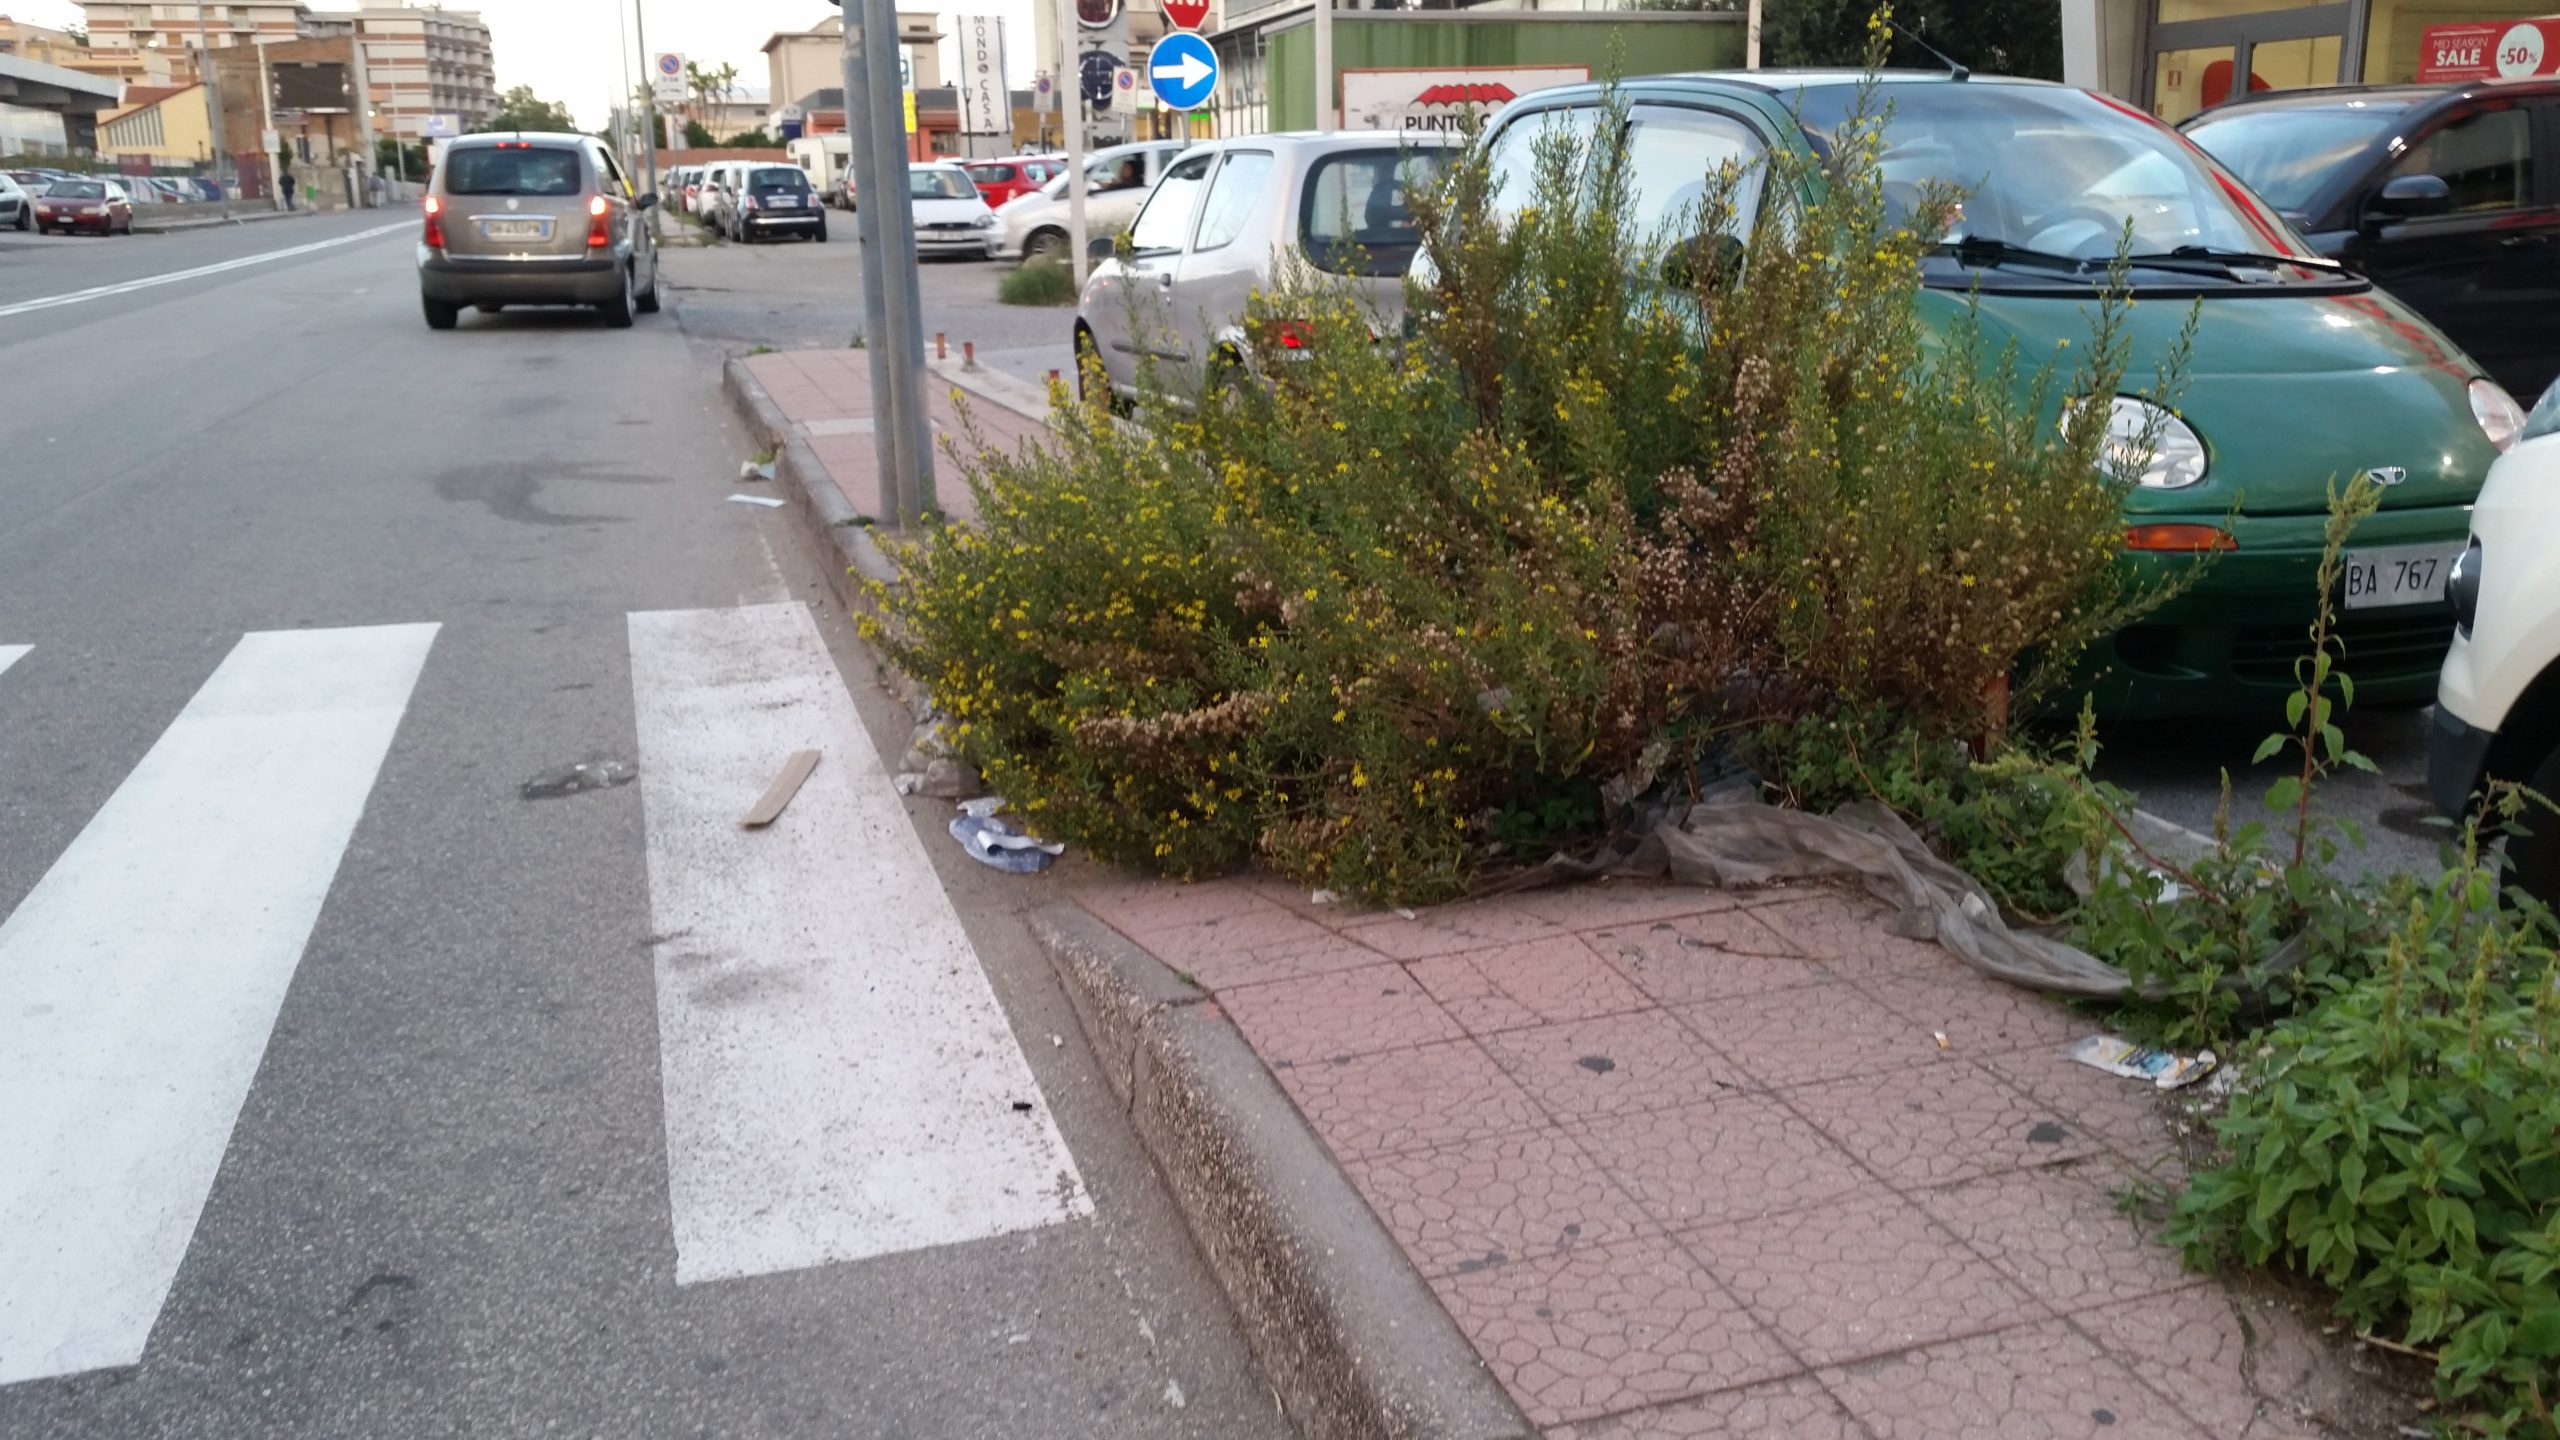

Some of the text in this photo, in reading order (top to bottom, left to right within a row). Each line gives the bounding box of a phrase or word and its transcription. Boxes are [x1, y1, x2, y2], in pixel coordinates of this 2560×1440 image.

[2433, 36, 2489, 50] MID SEASON
[2435, 47, 2482, 67] SALE
[2500, 46, 2538, 65] -50%
[974, 15, 993, 129] MONDO CASA
[2349, 559, 2438, 597] BA 767
